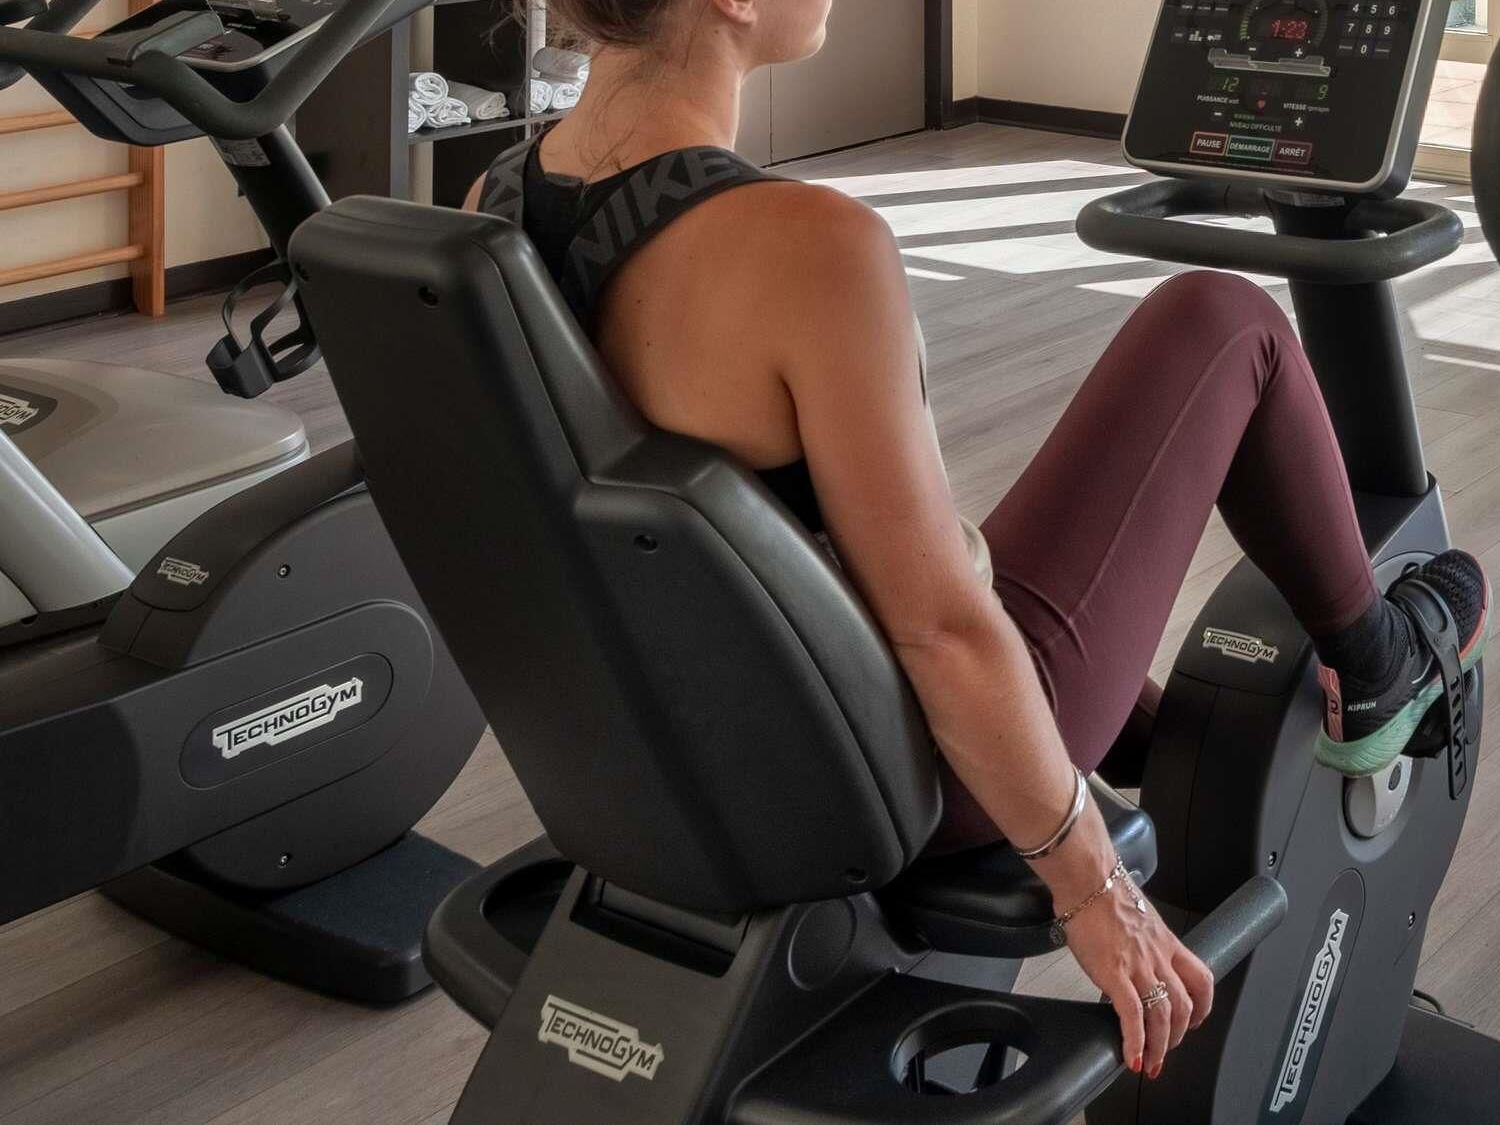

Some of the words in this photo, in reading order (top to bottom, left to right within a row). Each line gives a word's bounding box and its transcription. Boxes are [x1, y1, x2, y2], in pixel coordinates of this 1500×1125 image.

[1352, 3, 1359, 13] 4
[1370, 4, 1378, 14] 5
[1388, 5, 1395, 15] 6
[1272, 19, 1308, 39] 1:23
[1347, 23, 1355, 32] 7
[1365, 24, 1373, 34] 8
[1384, 25, 1391, 35] 9
[1360, 44, 1368, 54] 0
[1222, 77, 1239, 92] 12
[1196, 138, 1222, 148] PAUSE
[1279, 146, 1306, 157] ARRÊT
[568, 145, 748, 301] NIKE
[1204, 629, 1275, 660] TECHNOGYM
[216, 686, 357, 750] TECHNOGYM
[1274, 918, 1342, 1106] TECHNOGYM
[545, 1002, 657, 1070] TECHNOGYM
